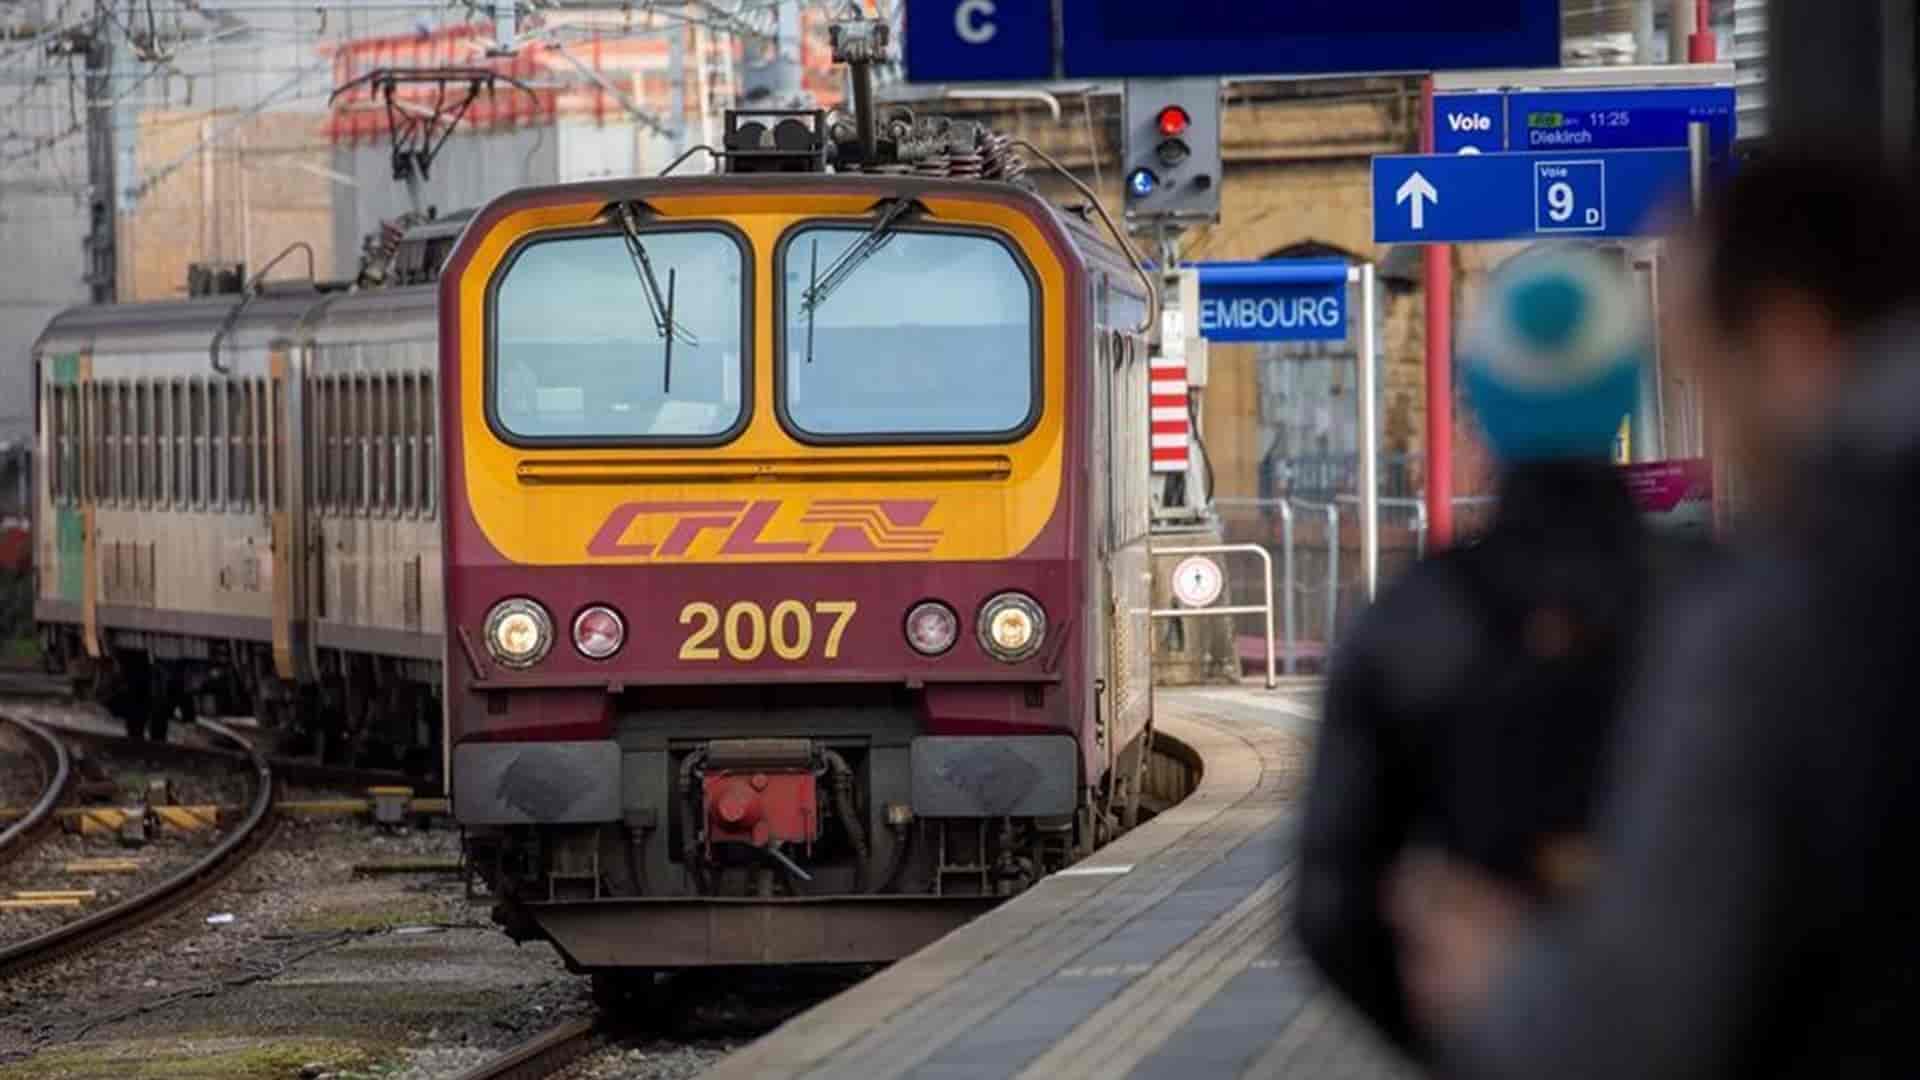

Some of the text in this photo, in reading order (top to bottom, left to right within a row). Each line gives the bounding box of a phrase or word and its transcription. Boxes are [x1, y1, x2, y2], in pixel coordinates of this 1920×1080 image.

[955, 0, 997, 44] C
[1448, 112, 1491, 132] Voie
[1590, 112, 1630, 126] 11:25
[1530, 131, 1592, 144] Diekirch
[1540, 167, 1568, 178] Voie
[1548, 182, 1599, 224] 9 D
[1201, 297, 1340, 329] EMBOURG
[586, 500, 811, 556] CFL
[678, 600, 857, 660] 2007
